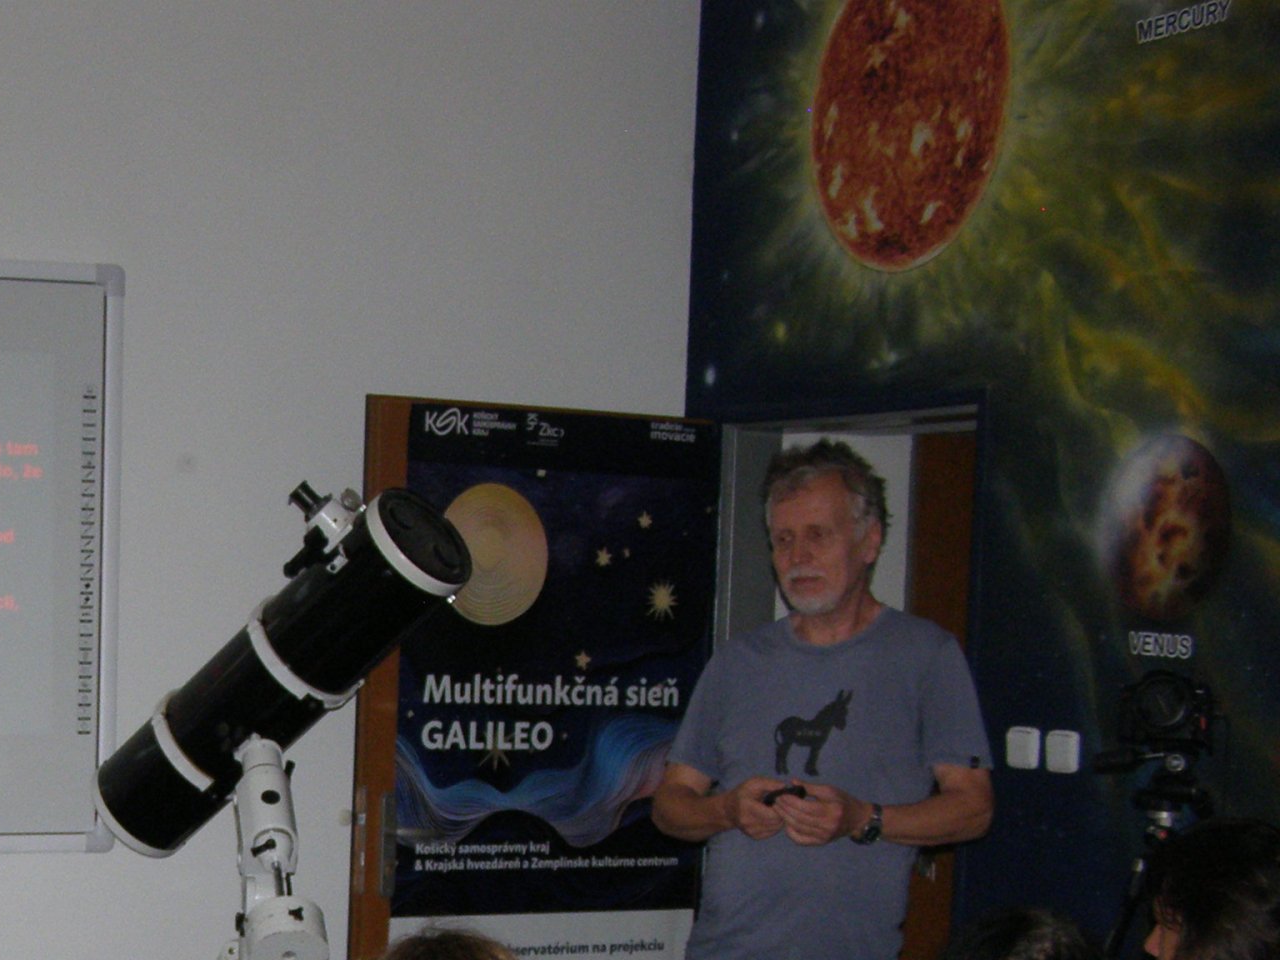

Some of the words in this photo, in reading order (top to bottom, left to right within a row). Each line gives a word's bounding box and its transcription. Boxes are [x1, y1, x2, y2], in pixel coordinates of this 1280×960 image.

[1137, 0, 1232, 44] MERCURY
[424, 408, 470, 436] KSK
[1128, 631, 1192, 659] VENUS
[422, 673, 618, 706] Multifunkčná
[625, 678, 680, 707] sieň
[421, 721, 553, 750] GALILEO
[415, 842, 457, 857] Košický
[458, 842, 527, 856] samosprávny
[529, 841, 550, 855] kraj
[424, 857, 465, 873] Krajská
[530, 857, 590, 871] Zemplínske
[591, 856, 636, 868] kultúrne
[637, 857, 679, 867] centrum
[592, 943, 607, 952] na
[609, 939, 665, 955] projekciu
